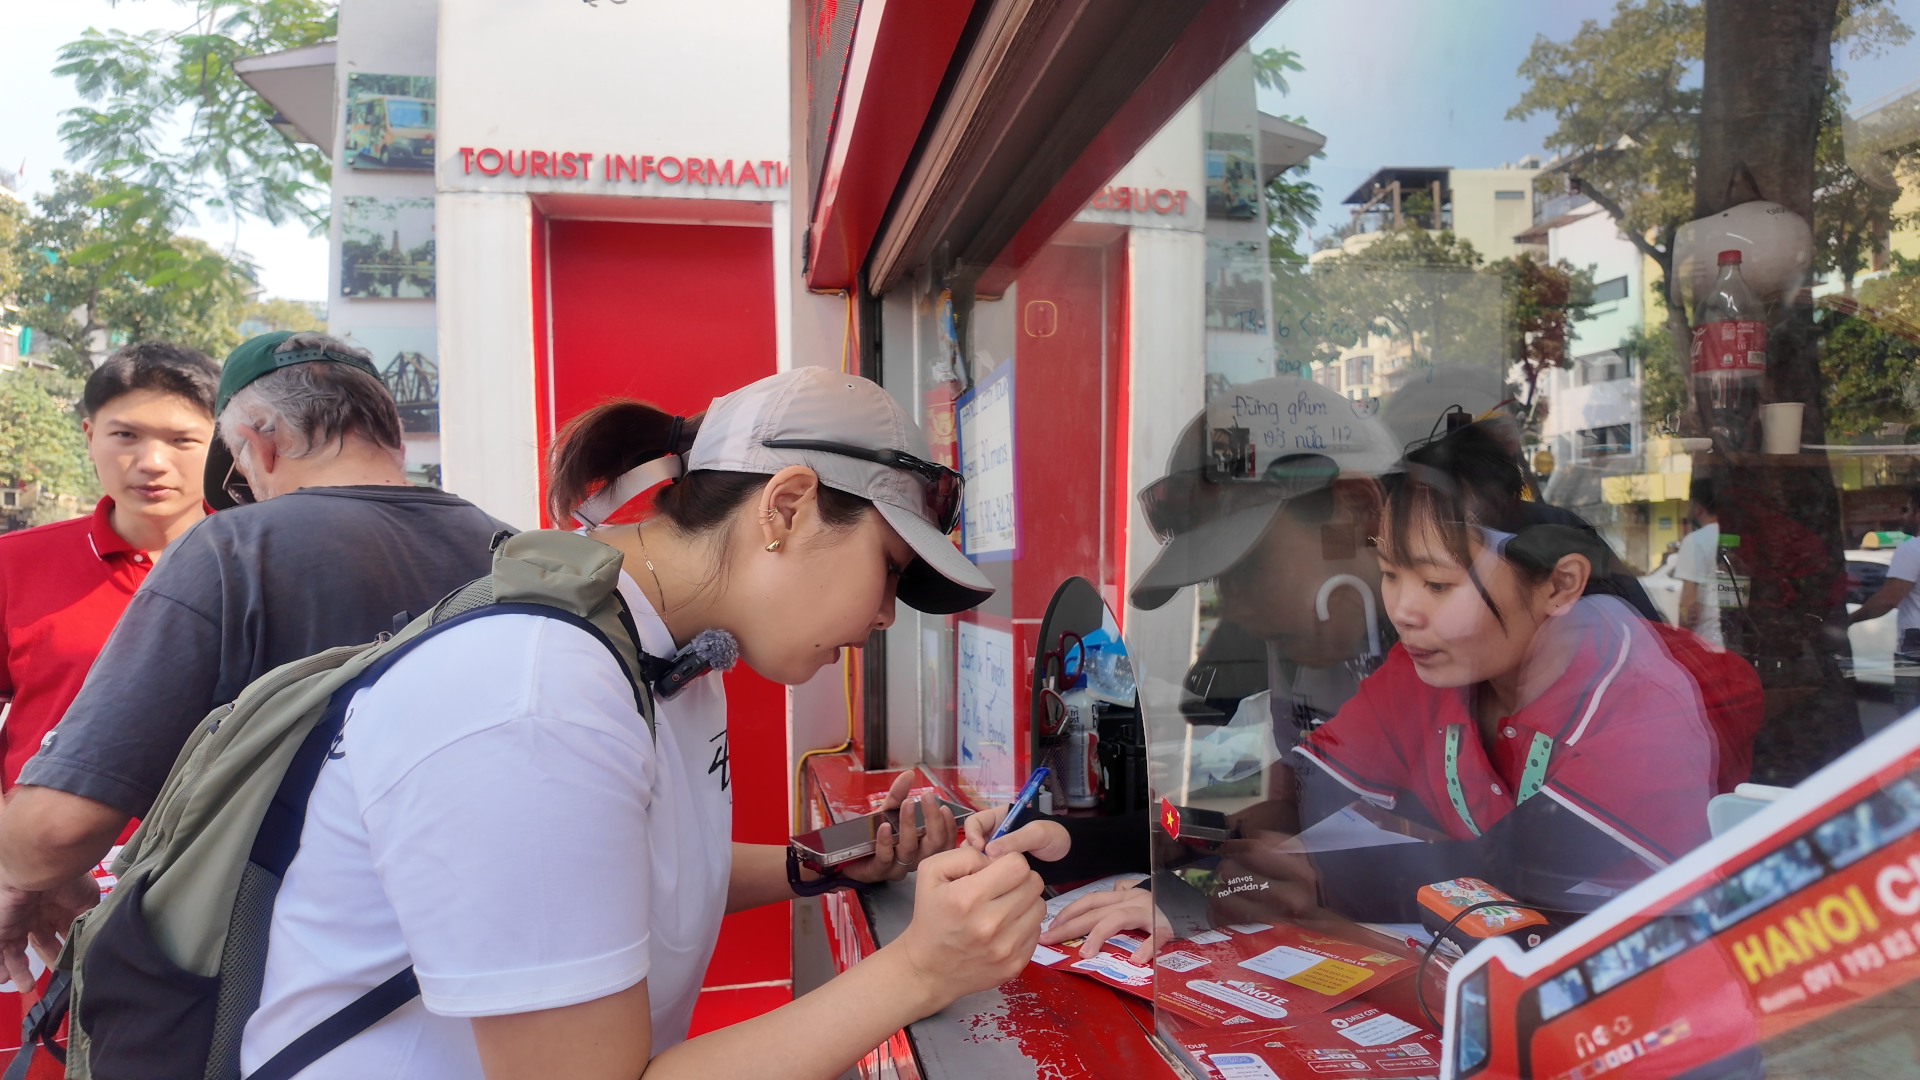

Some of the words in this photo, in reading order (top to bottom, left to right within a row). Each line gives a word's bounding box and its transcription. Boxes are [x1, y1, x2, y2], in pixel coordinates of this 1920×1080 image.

[459, 147, 593, 179] TOURIST
[1288, 391, 1329, 425] ghim
[985, 641, 1006, 688] Finish
[1217, 882, 1259, 898] upperyou
[1227, 875, 1253, 885] 50+UPF
[1732, 884, 1879, 984] HANOI
[1298, 945, 1321, 955] TICKET
[1320, 951, 1340, 959] PRICE
[1171, 991, 1202, 1005] BOOKING
[1201, 1002, 1227, 1014] ONLINE
[1243, 987, 1290, 1006] NOTE
[1345, 1013, 1365, 1024] DAILY
[1364, 1008, 1380, 1018] CITY
